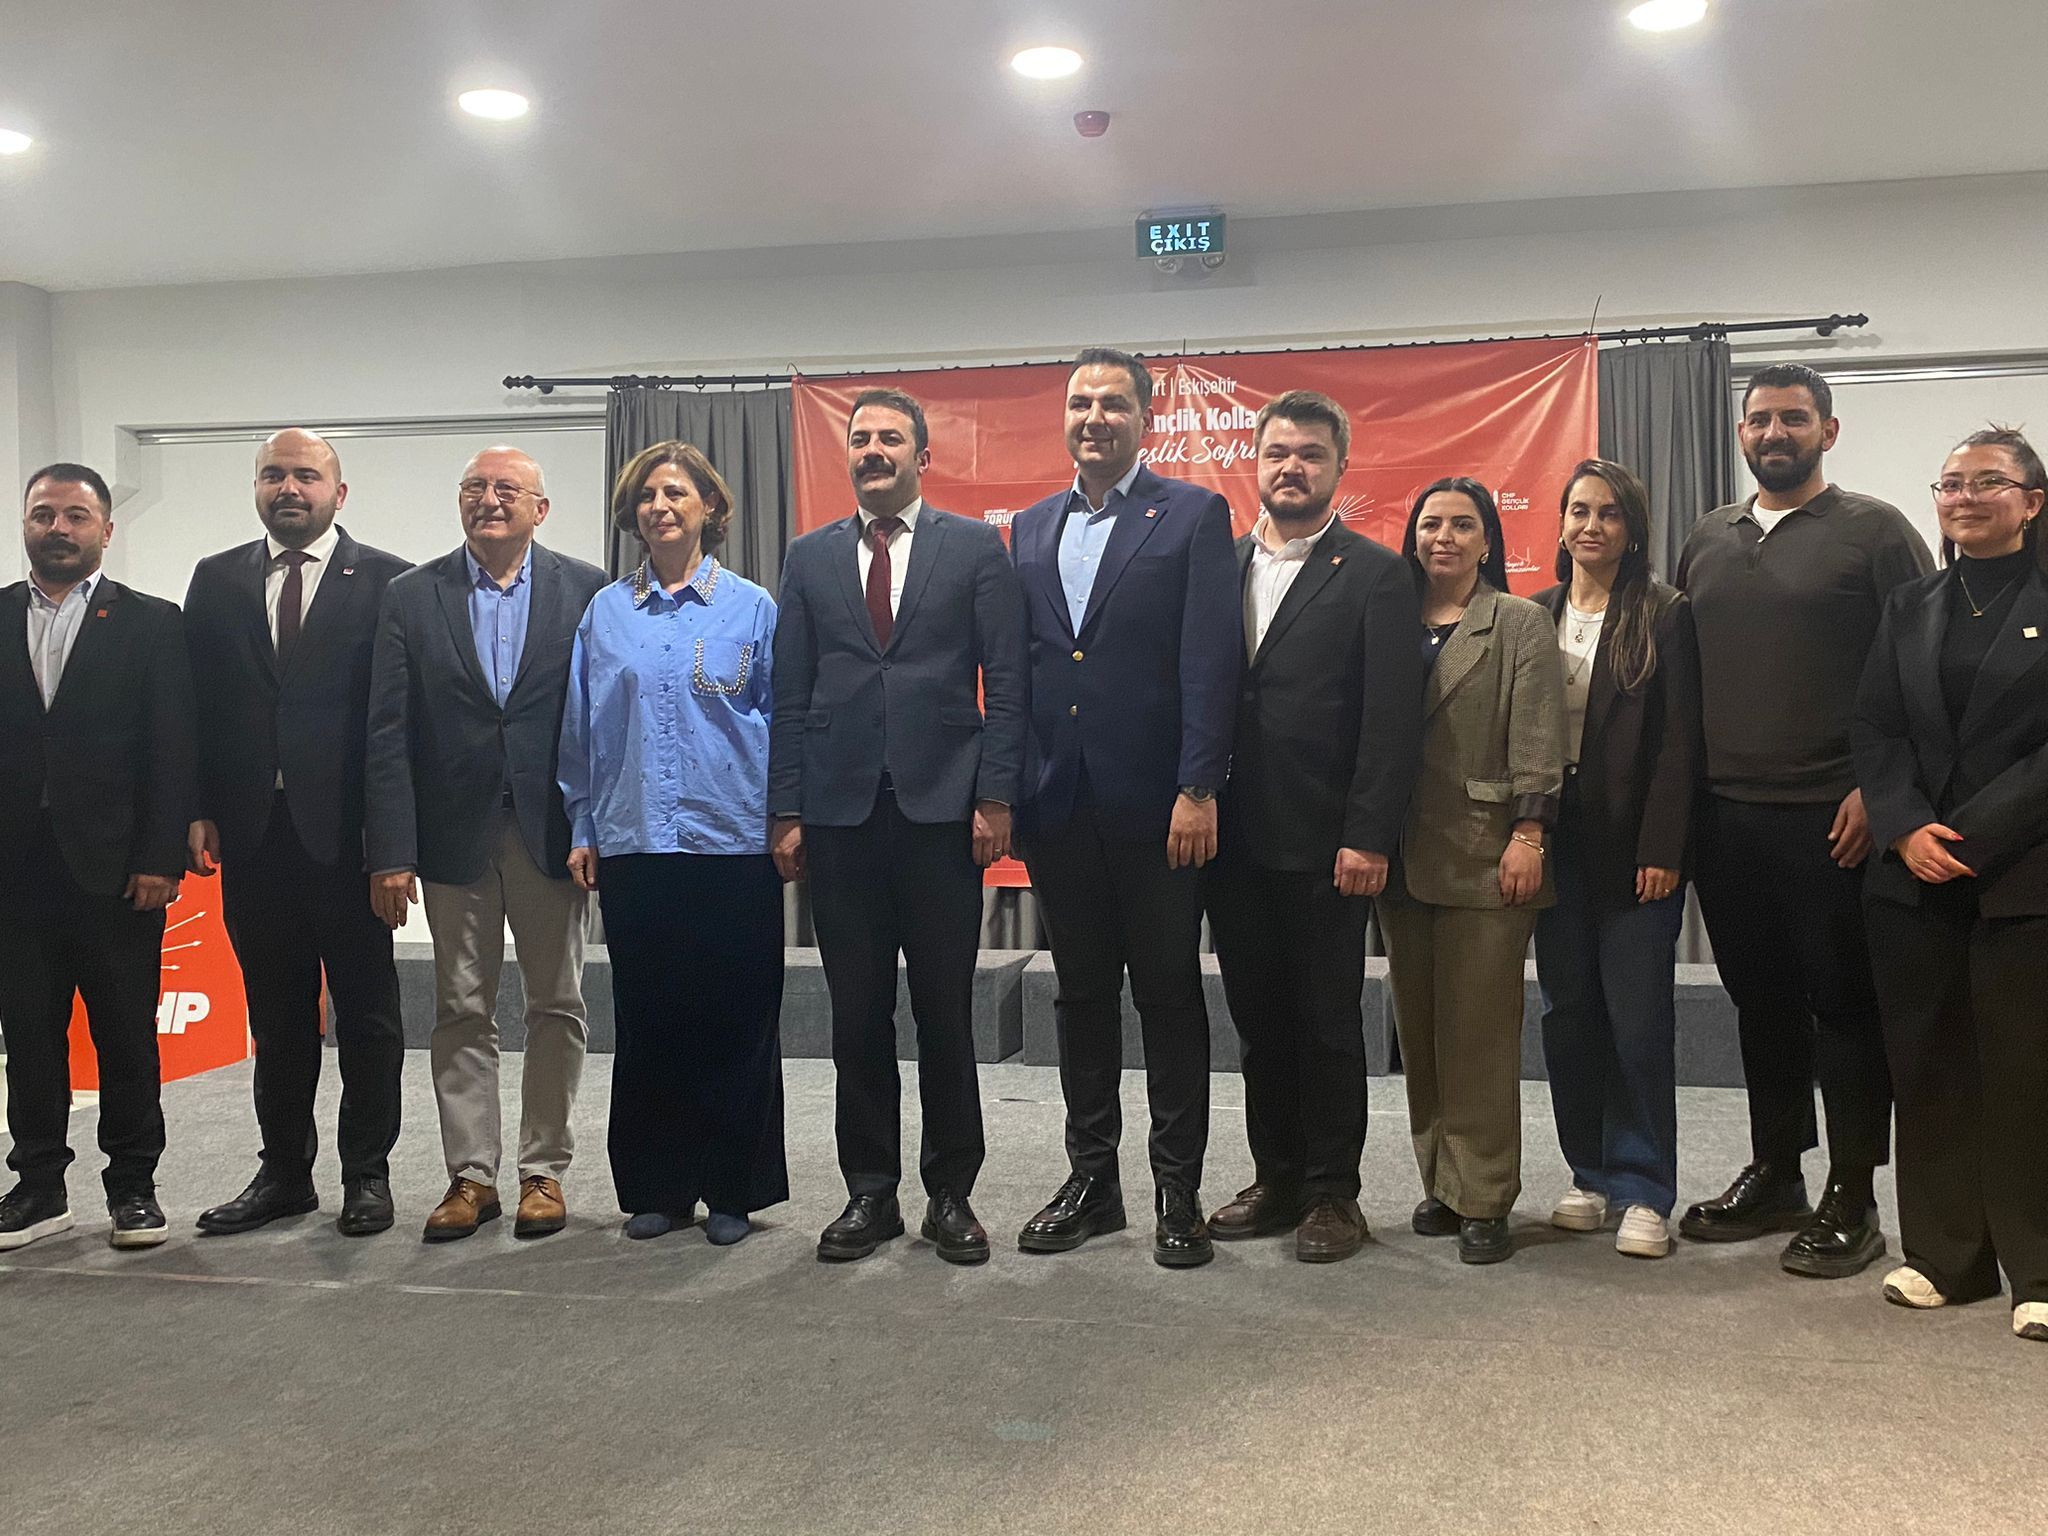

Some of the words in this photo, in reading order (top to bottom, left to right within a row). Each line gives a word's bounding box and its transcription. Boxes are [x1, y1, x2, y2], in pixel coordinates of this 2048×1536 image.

[1150, 222, 1210, 240] EXIT
[1150, 236, 1211, 255] ÇIKIŞ
[1152, 379, 1166, 397] rt
[1178, 376, 1237, 397] Eskişehir
[1151, 408, 1202, 436] nçlik
[1137, 436, 1191, 471] eşlik
[156, 991, 210, 1035] HP
